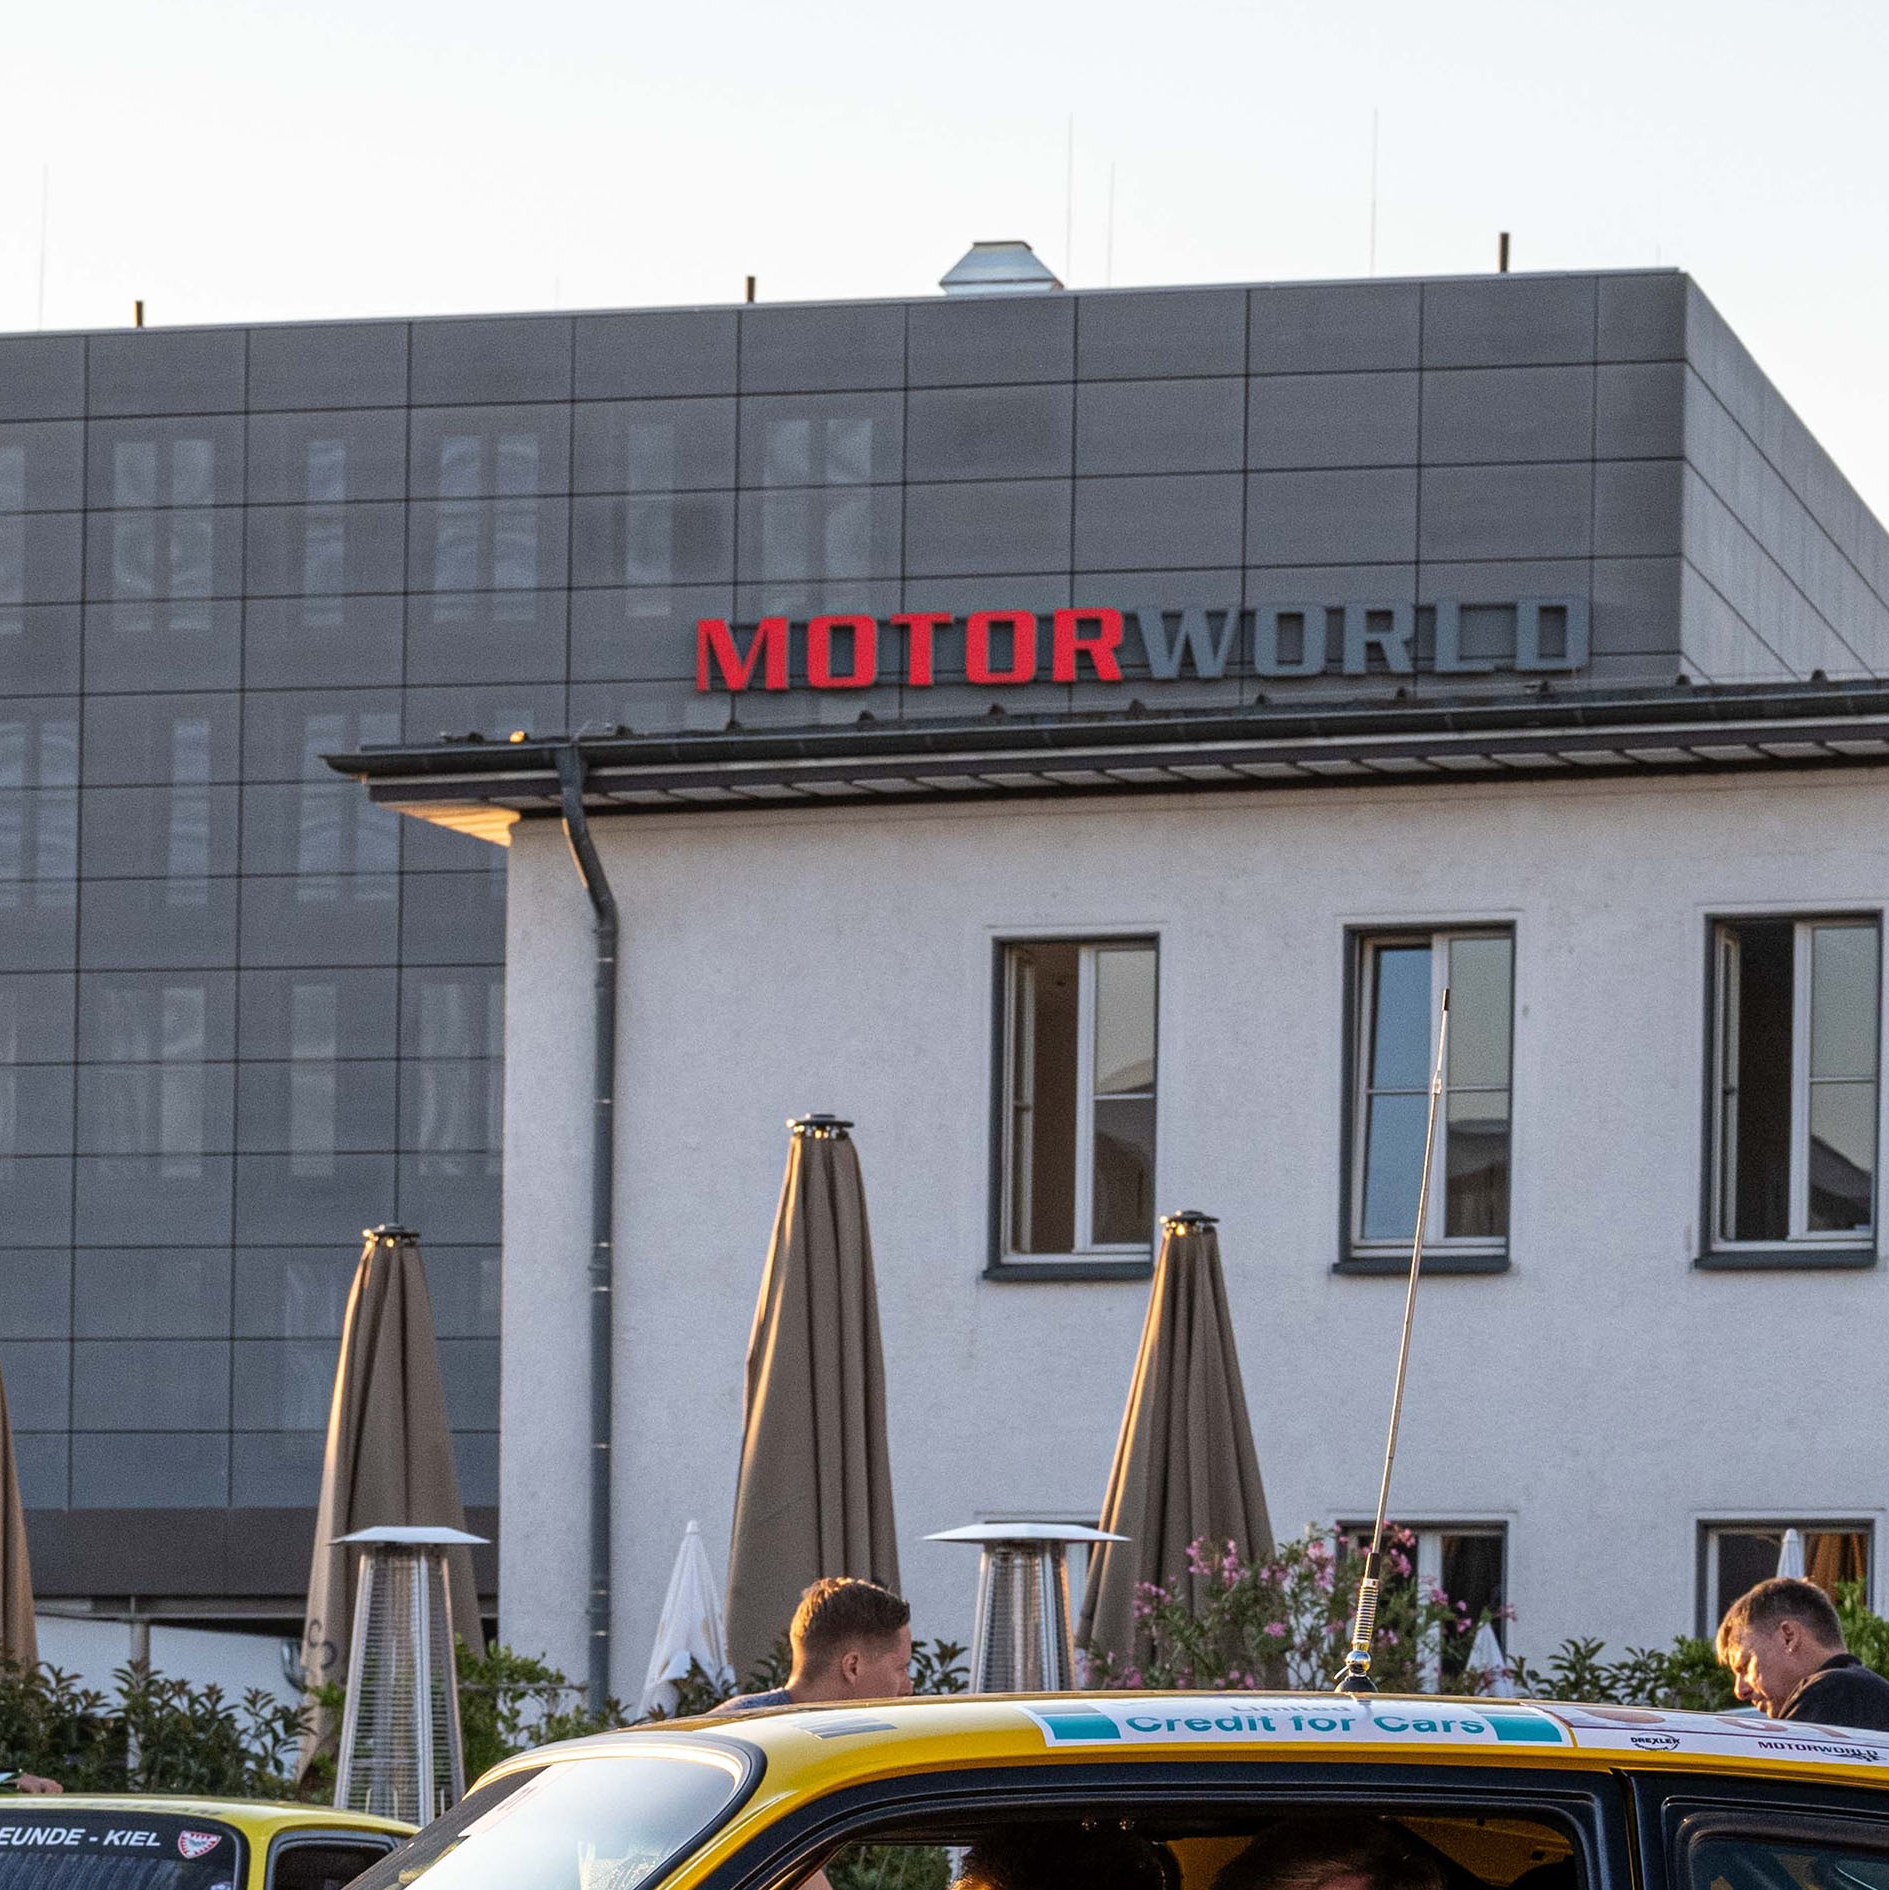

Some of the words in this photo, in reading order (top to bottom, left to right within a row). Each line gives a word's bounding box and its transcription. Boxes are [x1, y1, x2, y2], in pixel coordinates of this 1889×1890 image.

[696, 597, 1592, 693] MOTORWORLD
[1125, 1714, 1276, 1732] Credit
[1288, 1714, 1357, 1732] for
[1373, 1716, 1486, 1734] Cars
[1758, 1741, 1879, 1757] MOTORWORLD
[103, 1829, 161, 1847] KIEL
